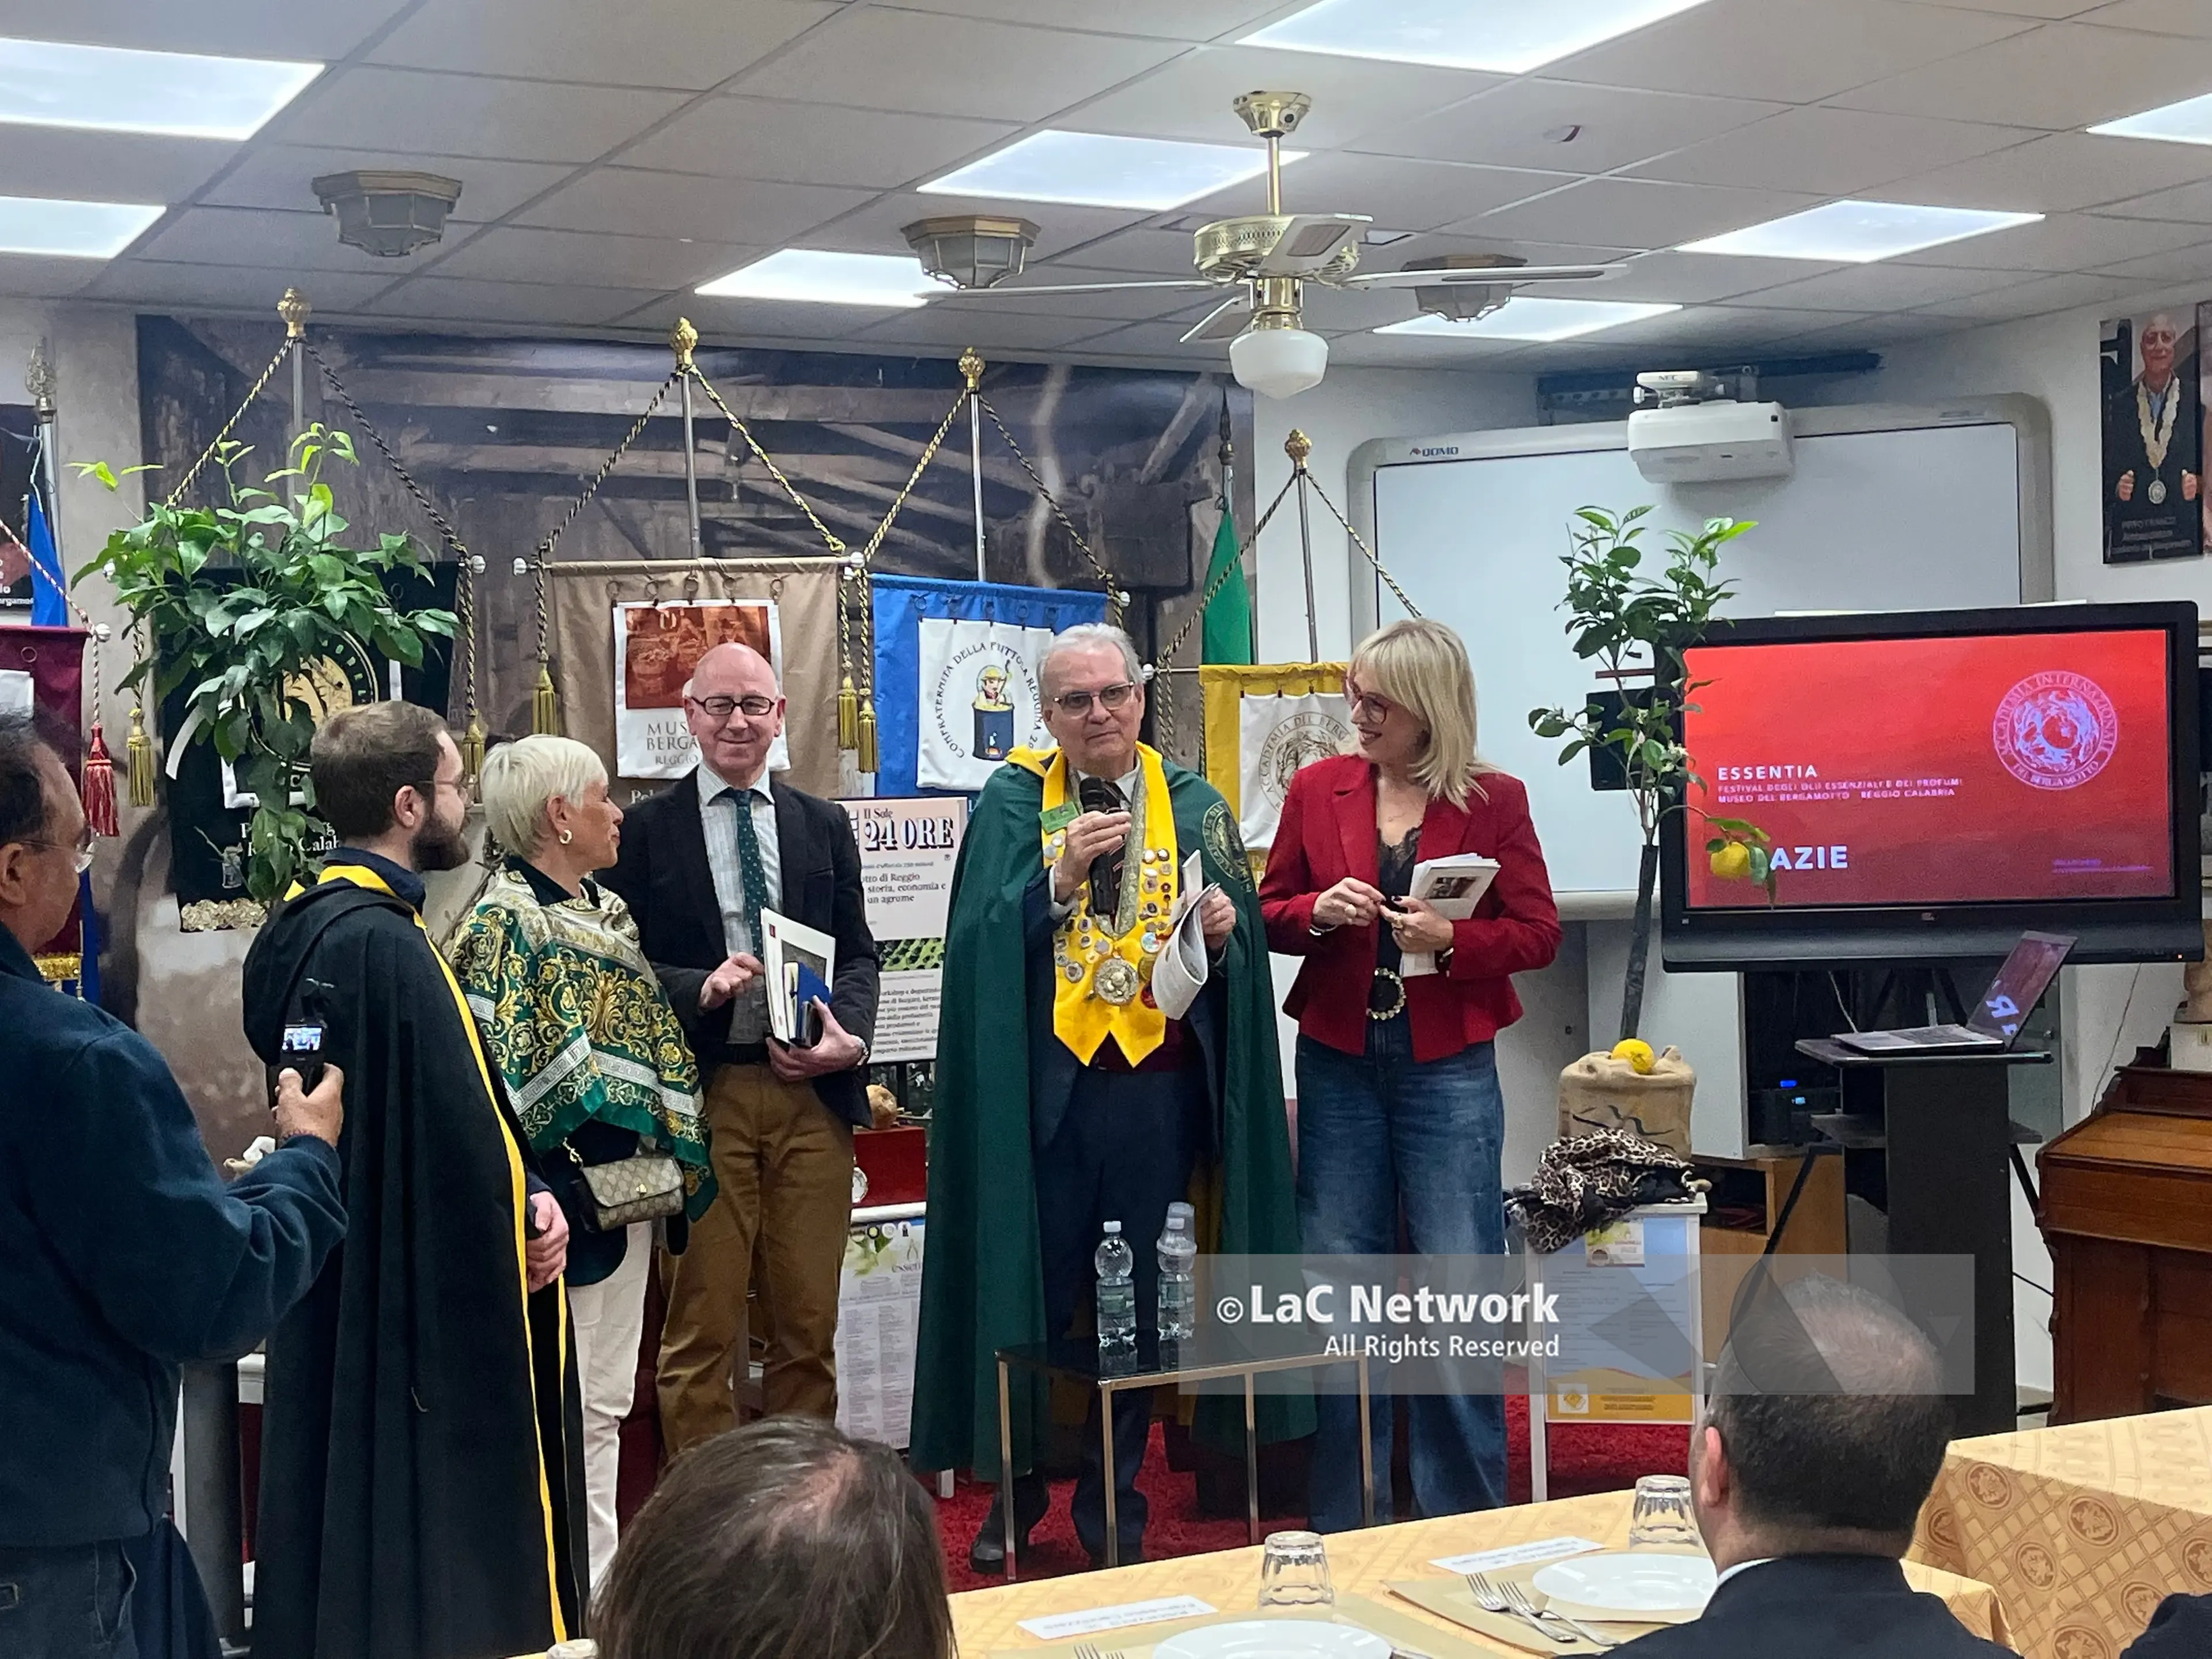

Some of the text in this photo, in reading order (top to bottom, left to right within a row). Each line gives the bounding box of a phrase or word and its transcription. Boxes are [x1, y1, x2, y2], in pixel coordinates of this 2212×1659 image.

[952, 642, 987, 665] DELLA
[1717, 764, 1819, 781] ESSENTIA
[1718, 783, 1763, 794] FESTIVAL
[1916, 778, 1964, 787] PROFUMI
[1718, 788, 1956, 804] MUSEO DEL BERGAMOTTO REGGIO CALABRIA
[863, 808, 893, 819] Il Sole
[864, 819, 898, 851] 24
[900, 817, 955, 850] ORE
[880, 873, 888, 882] di
[891, 872, 921, 883] Reggio
[867, 884, 895, 893] storia,
[897, 882, 939, 891] economia
[881, 895, 915, 906] agrume
